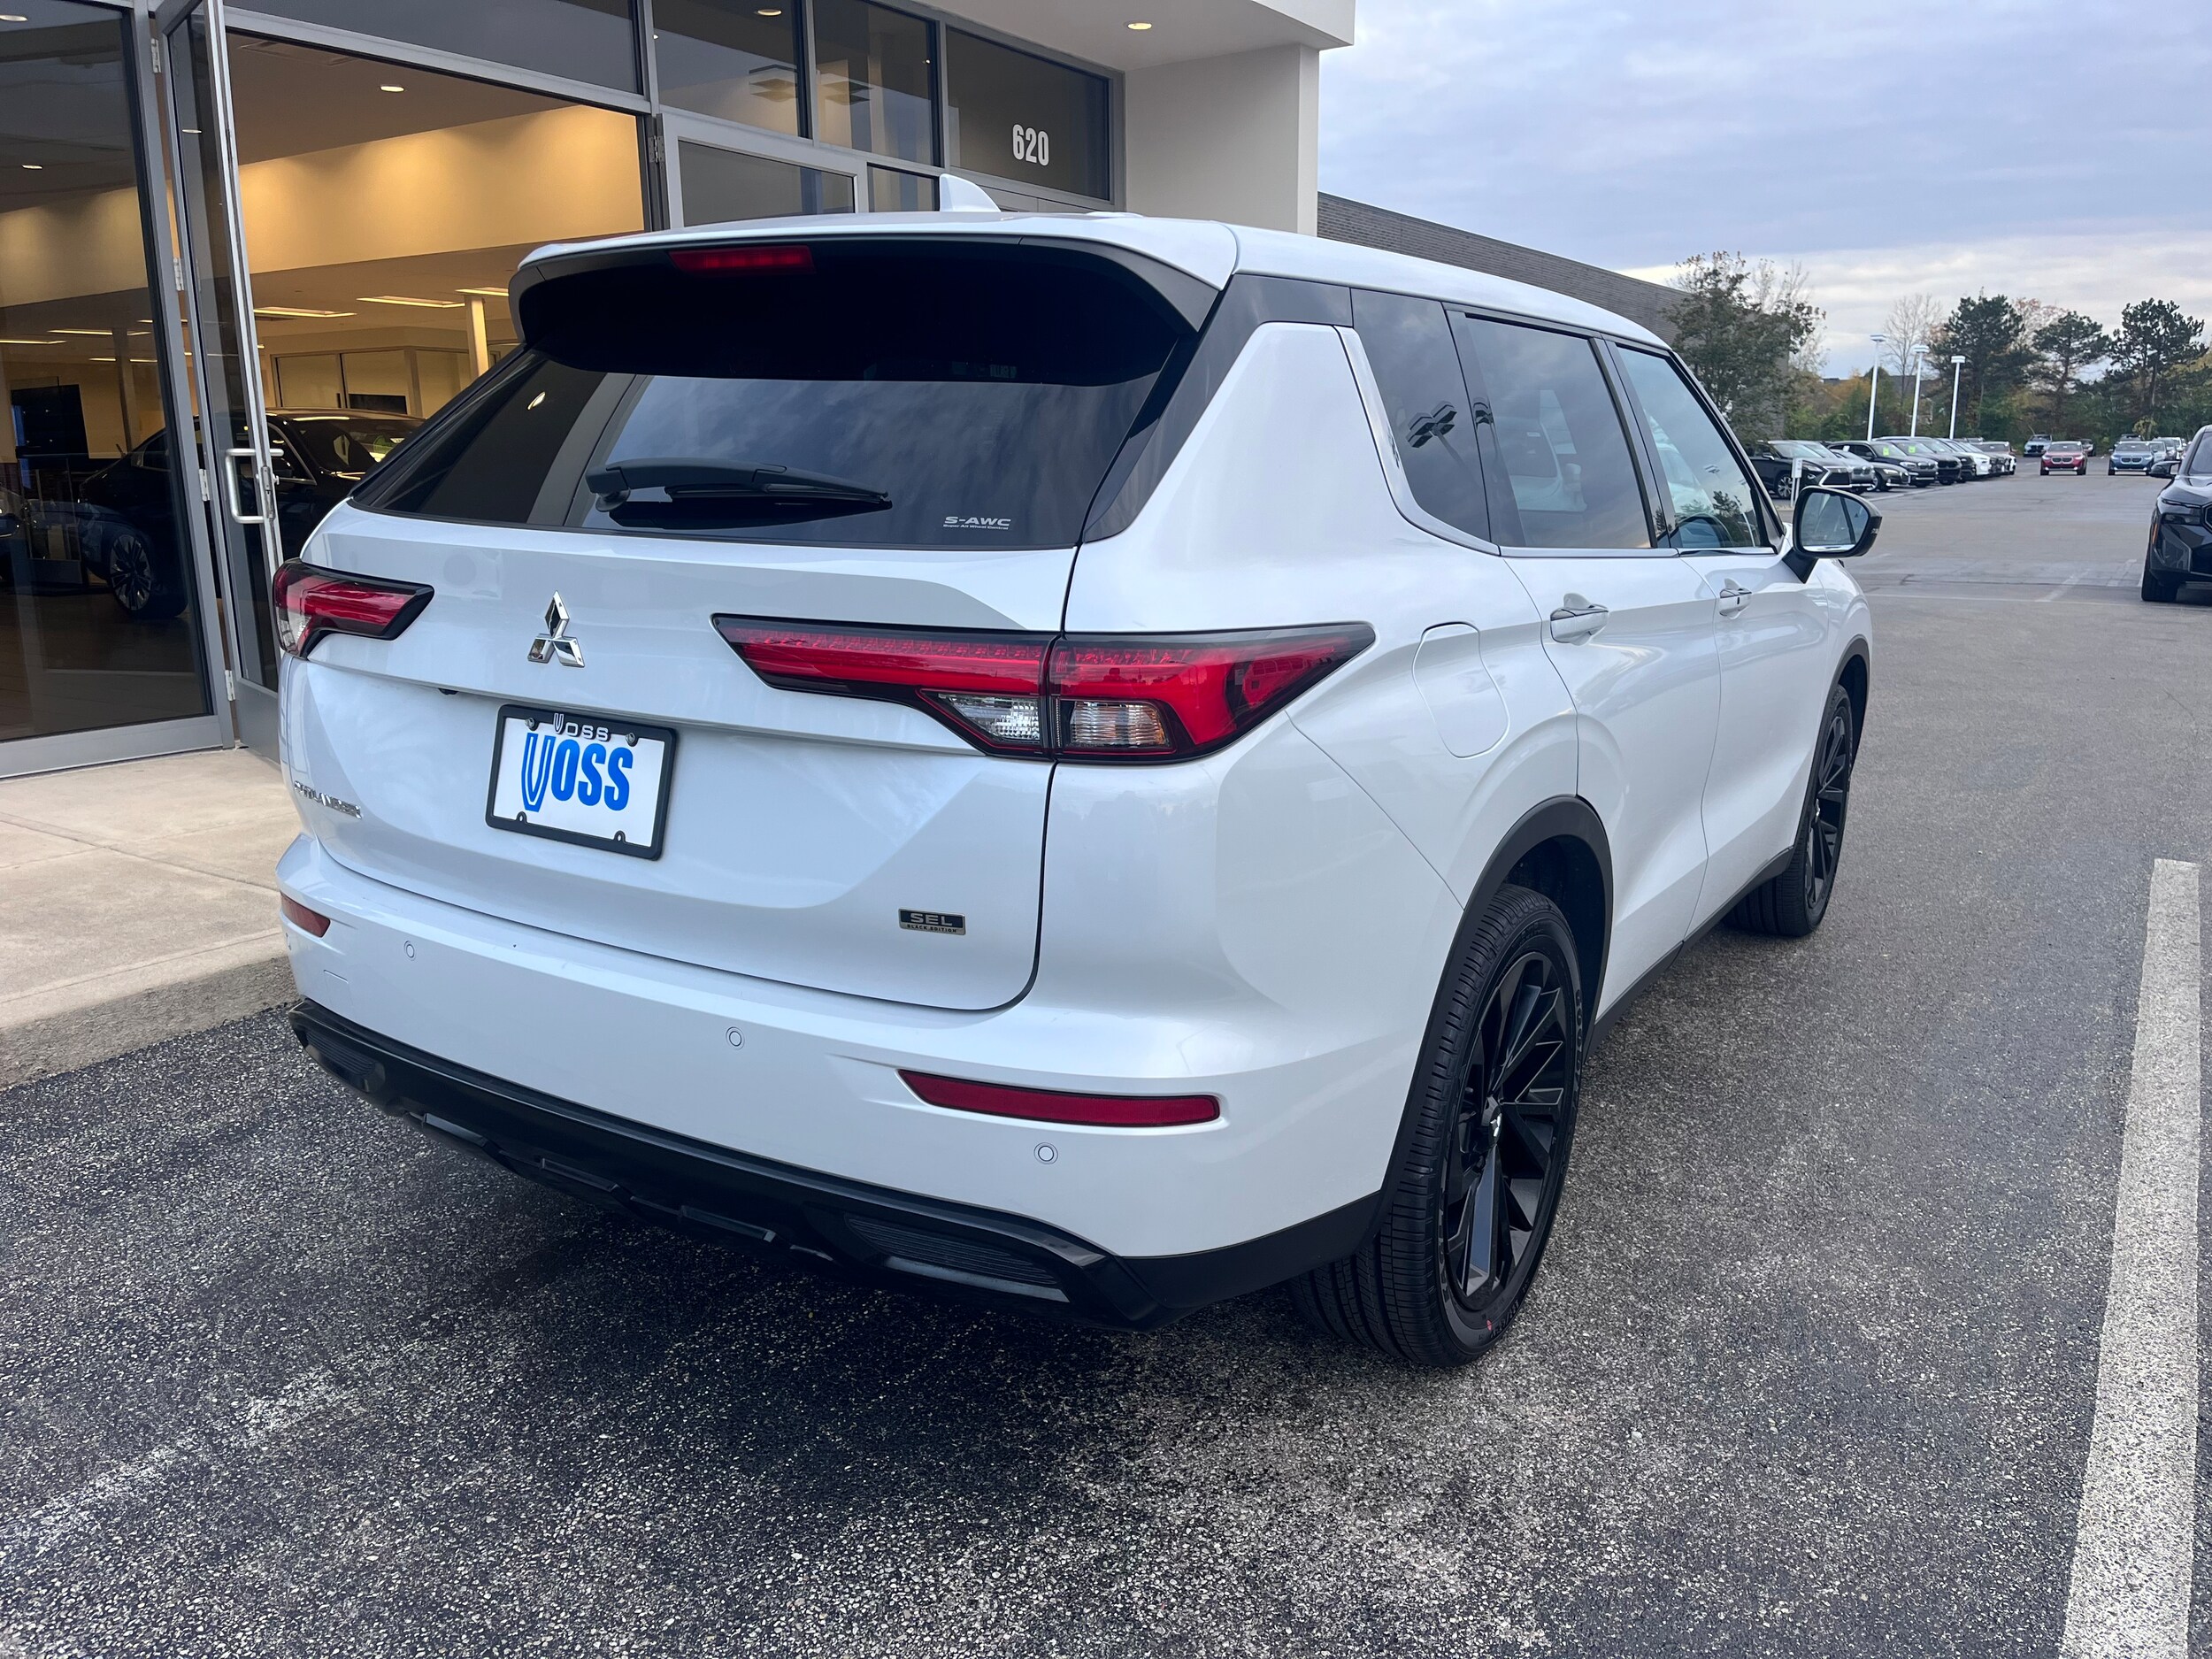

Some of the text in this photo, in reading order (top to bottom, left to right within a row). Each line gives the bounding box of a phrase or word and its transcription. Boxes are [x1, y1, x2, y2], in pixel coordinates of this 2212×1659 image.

[1012, 124, 1049, 165] 620
[944, 516, 1011, 526] S-AWC
[521, 732, 634, 812] VOSS
[910, 912, 953, 926] SEL
